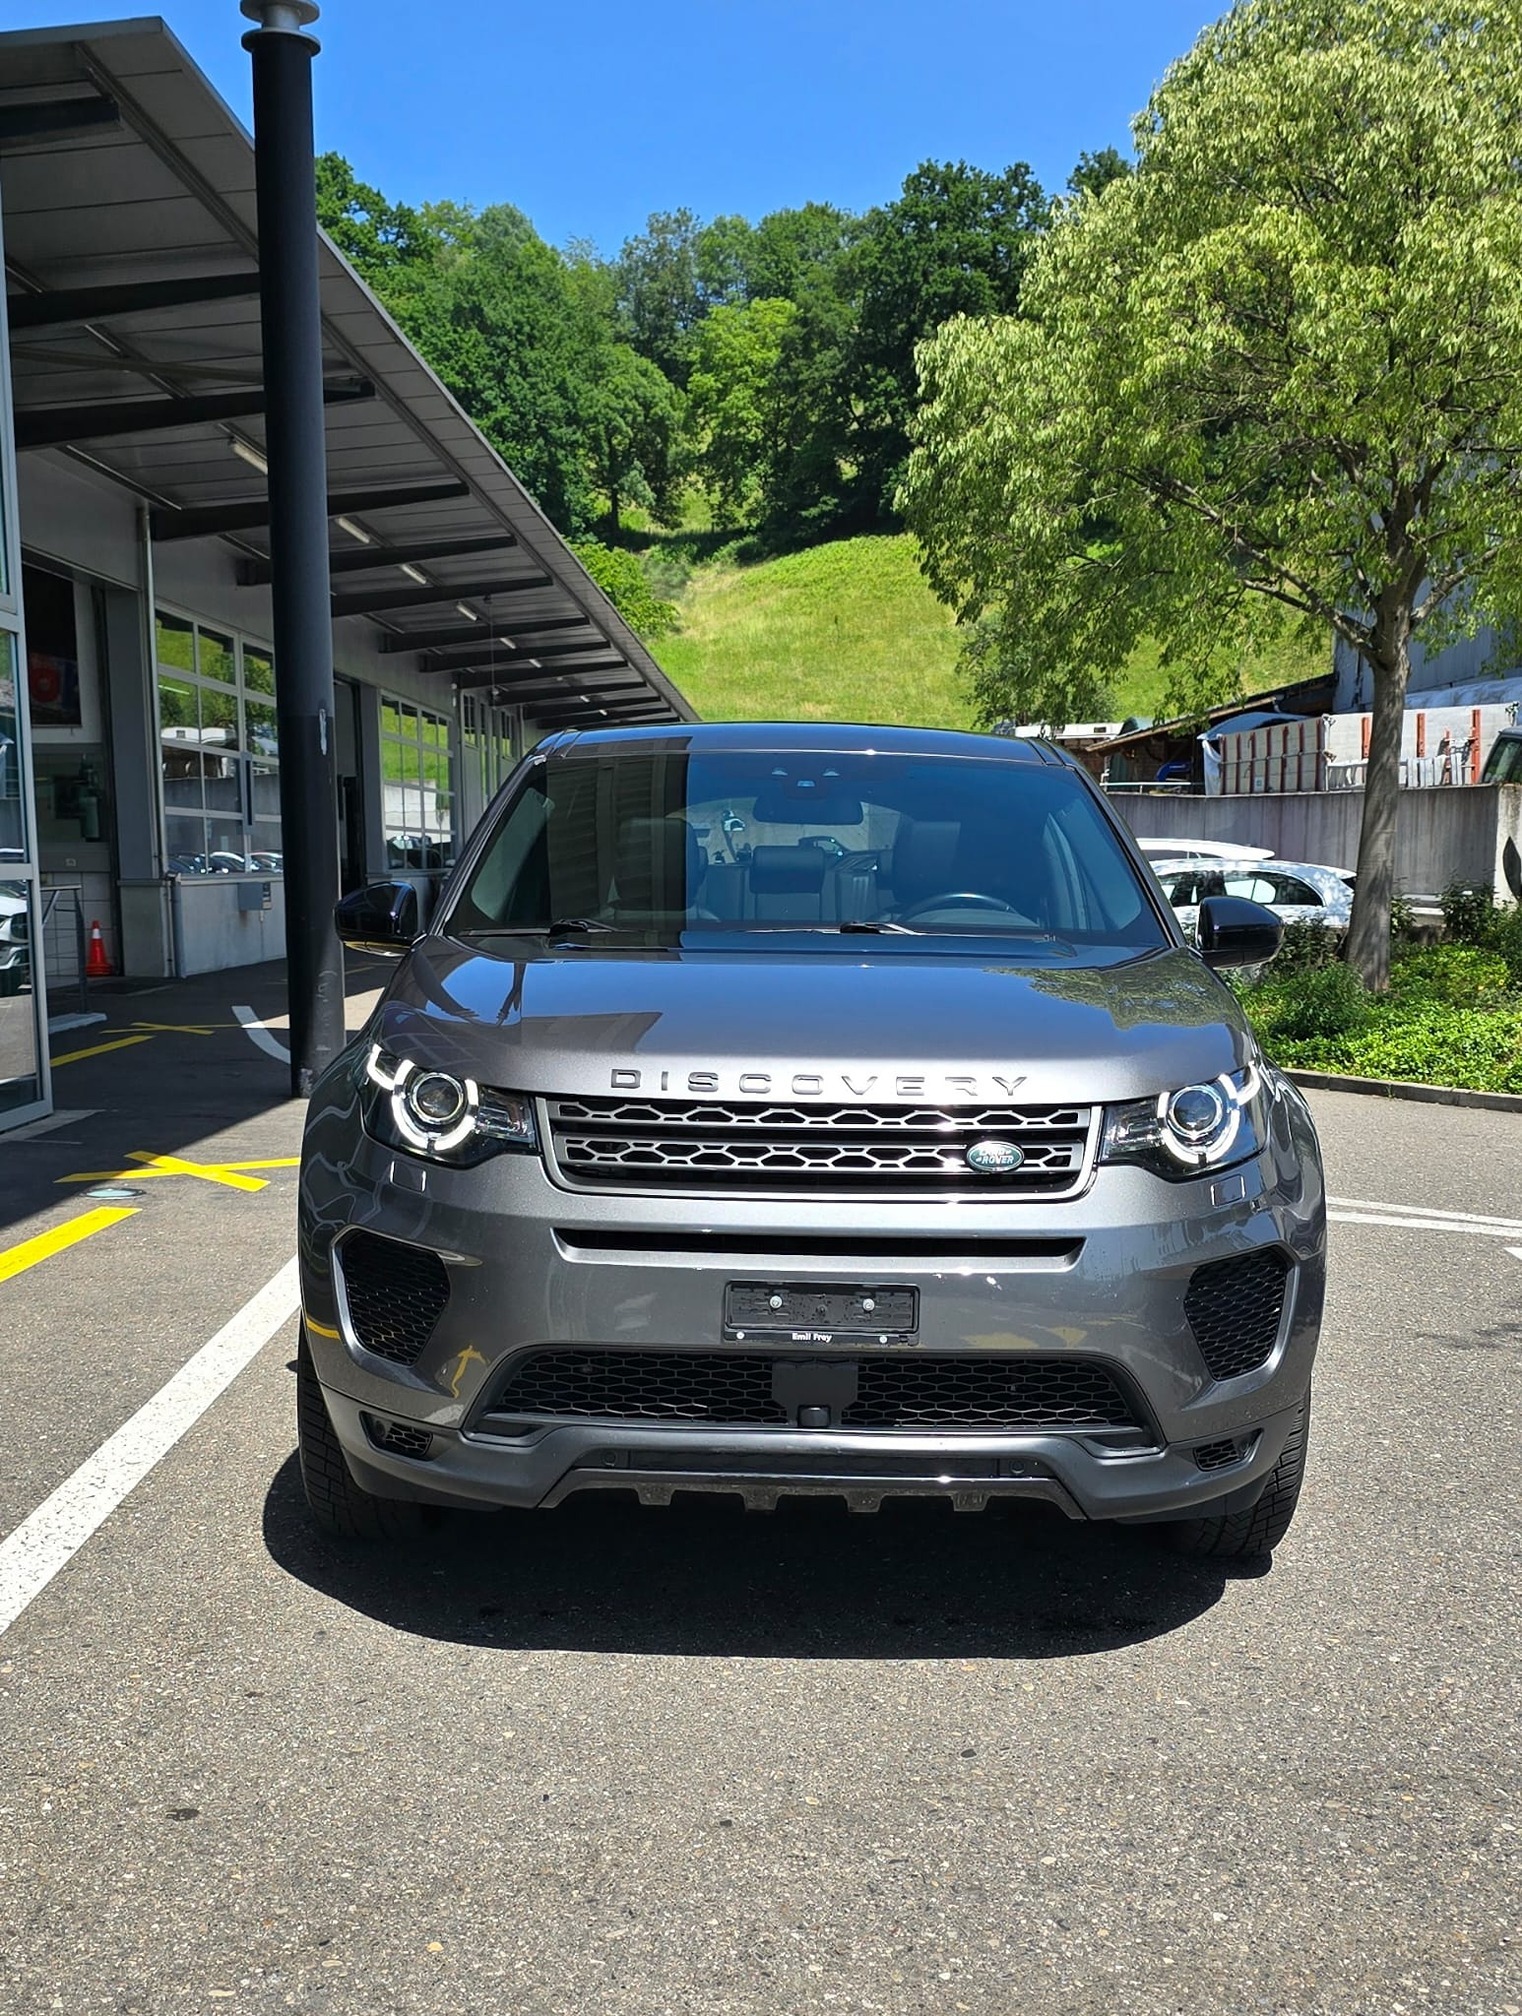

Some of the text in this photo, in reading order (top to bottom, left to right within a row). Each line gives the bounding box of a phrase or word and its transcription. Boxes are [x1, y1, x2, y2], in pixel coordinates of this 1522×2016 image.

[611, 1068, 1028, 1097] DISCOVERY
[981, 1155, 1014, 1164] ROVER
[792, 1332, 832, 1343] Emil Frey
